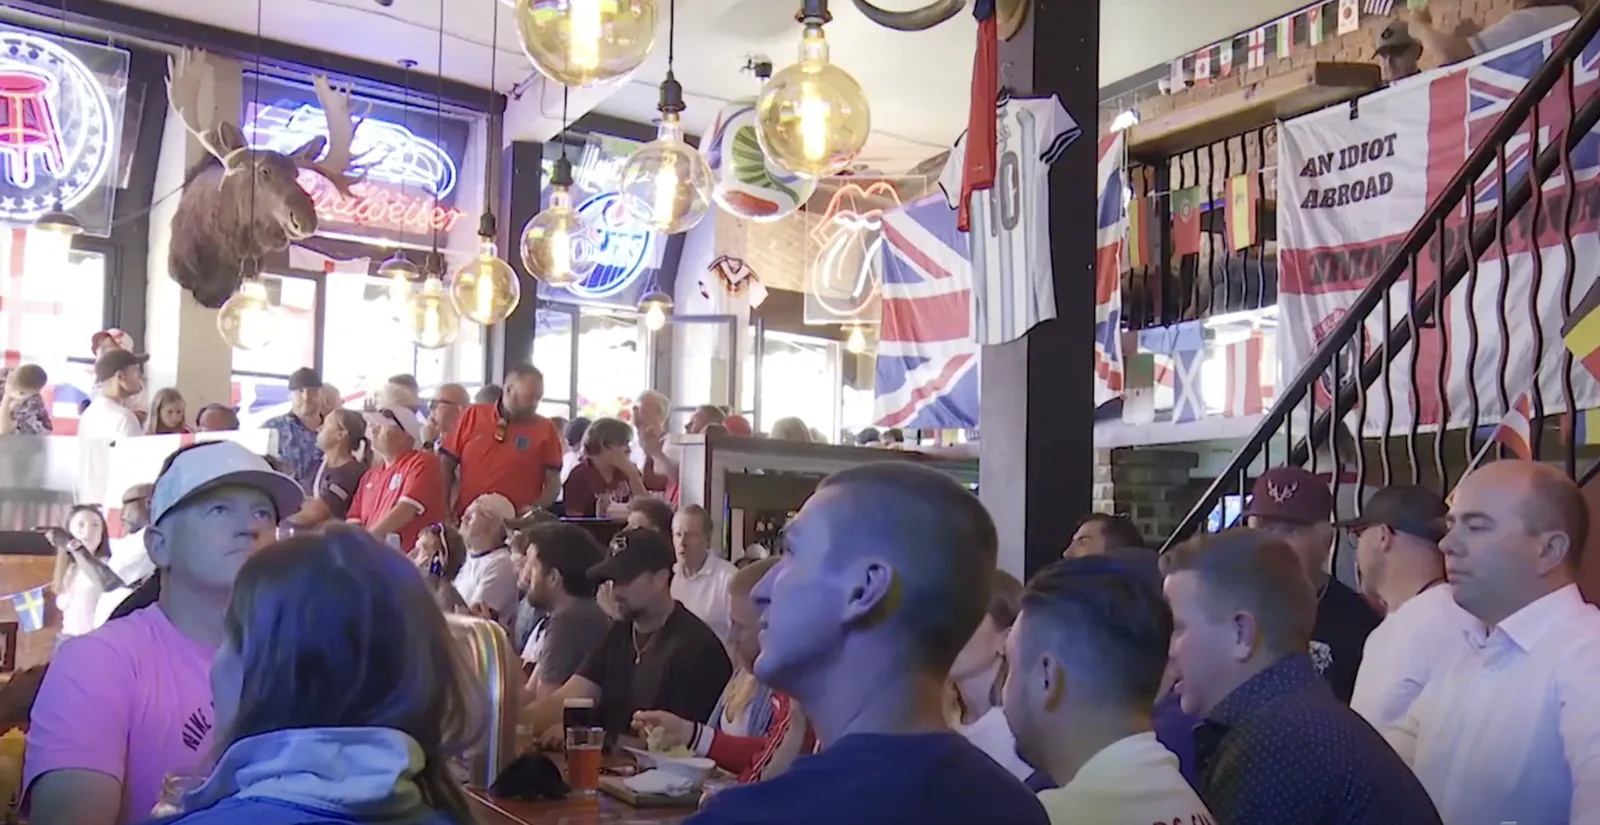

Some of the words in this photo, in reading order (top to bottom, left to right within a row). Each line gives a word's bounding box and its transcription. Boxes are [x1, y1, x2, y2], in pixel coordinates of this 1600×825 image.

[1299, 152, 1334, 177] AN
[1338, 132, 1397, 171] IDIOT
[1300, 171, 1394, 209] ABROAD
[182, 707, 212, 752] NIKE
